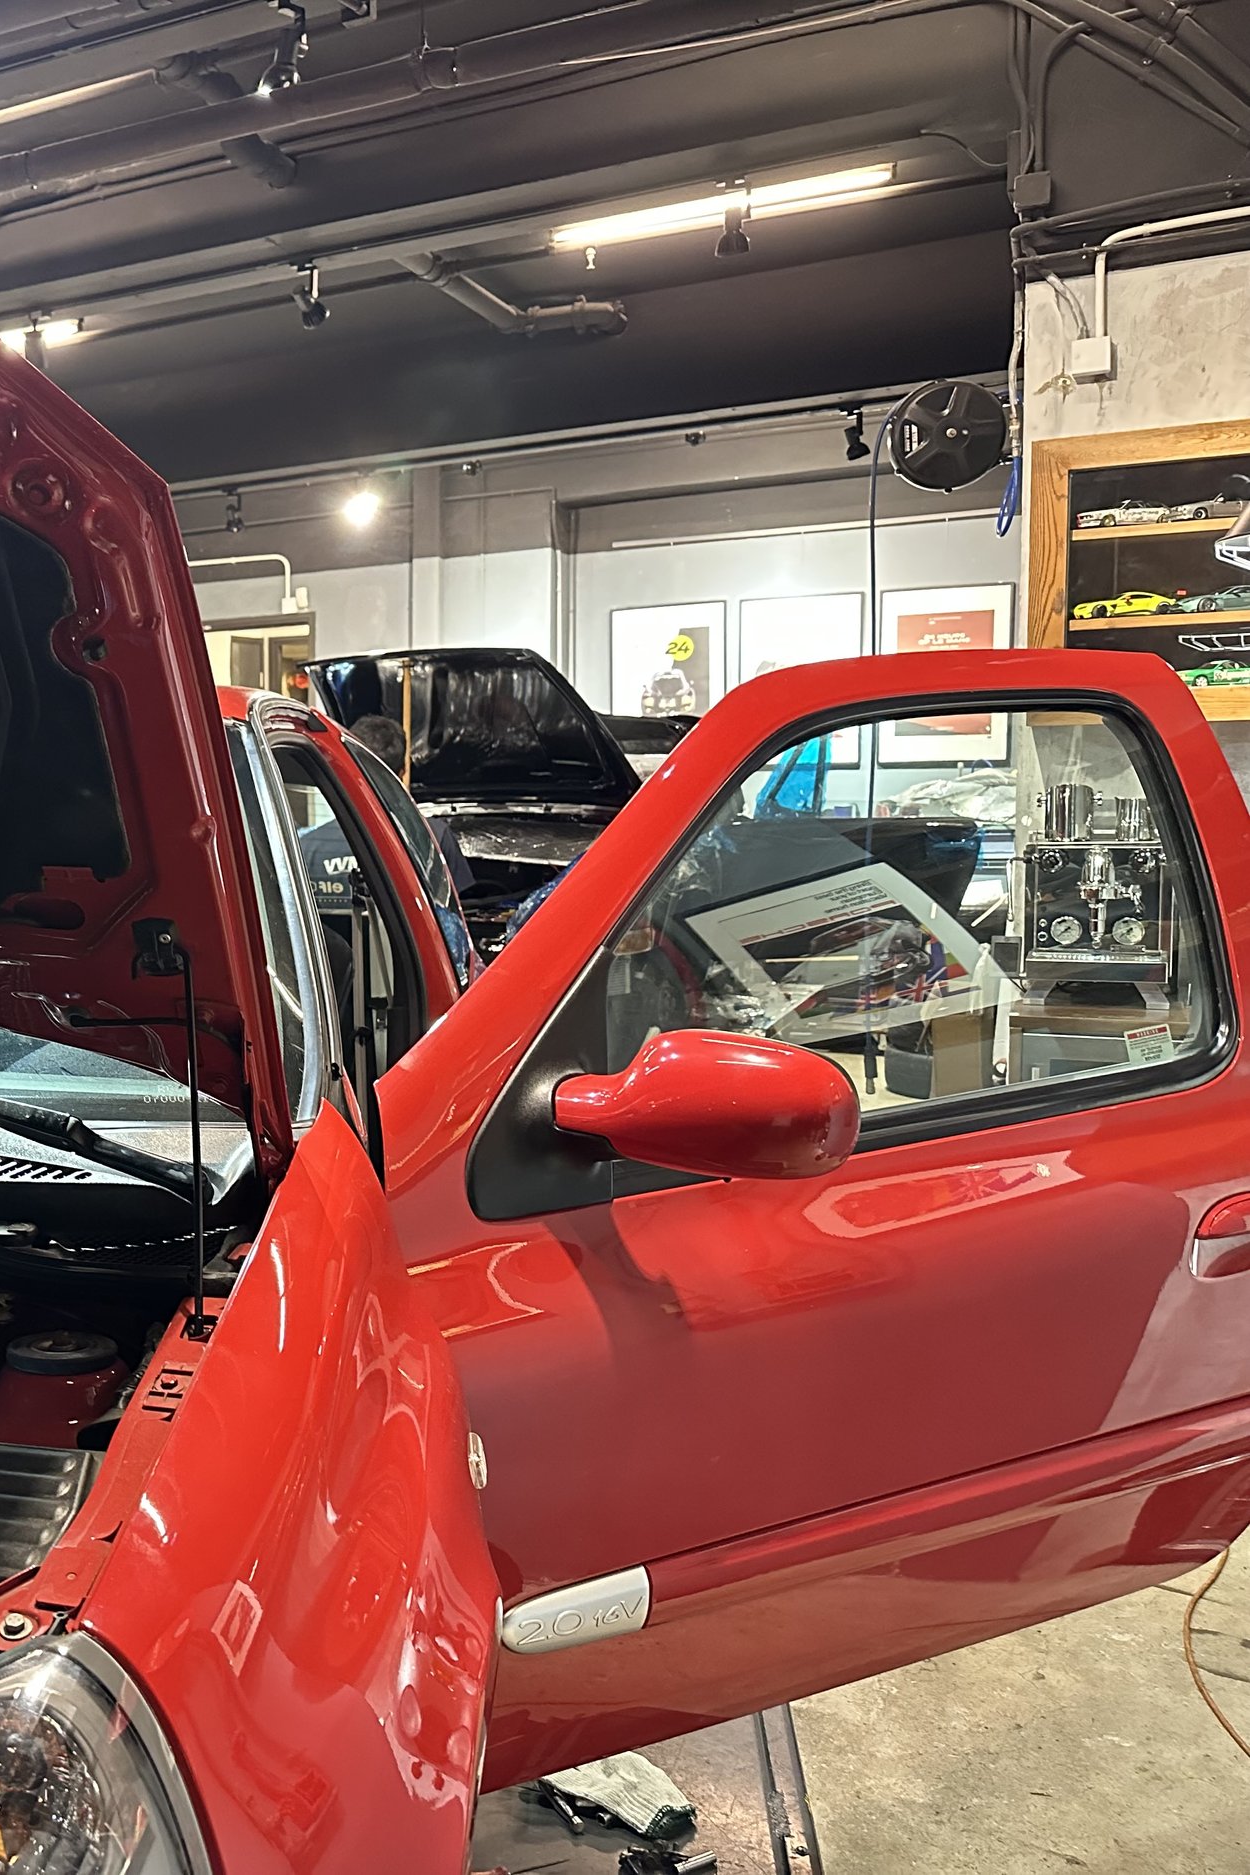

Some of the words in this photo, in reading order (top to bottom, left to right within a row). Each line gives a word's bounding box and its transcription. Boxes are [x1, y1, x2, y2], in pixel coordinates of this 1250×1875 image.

[665, 641, 690, 655] 24
[516, 1609, 585, 1647] 2.0
[592, 1595, 646, 1629] 16V
